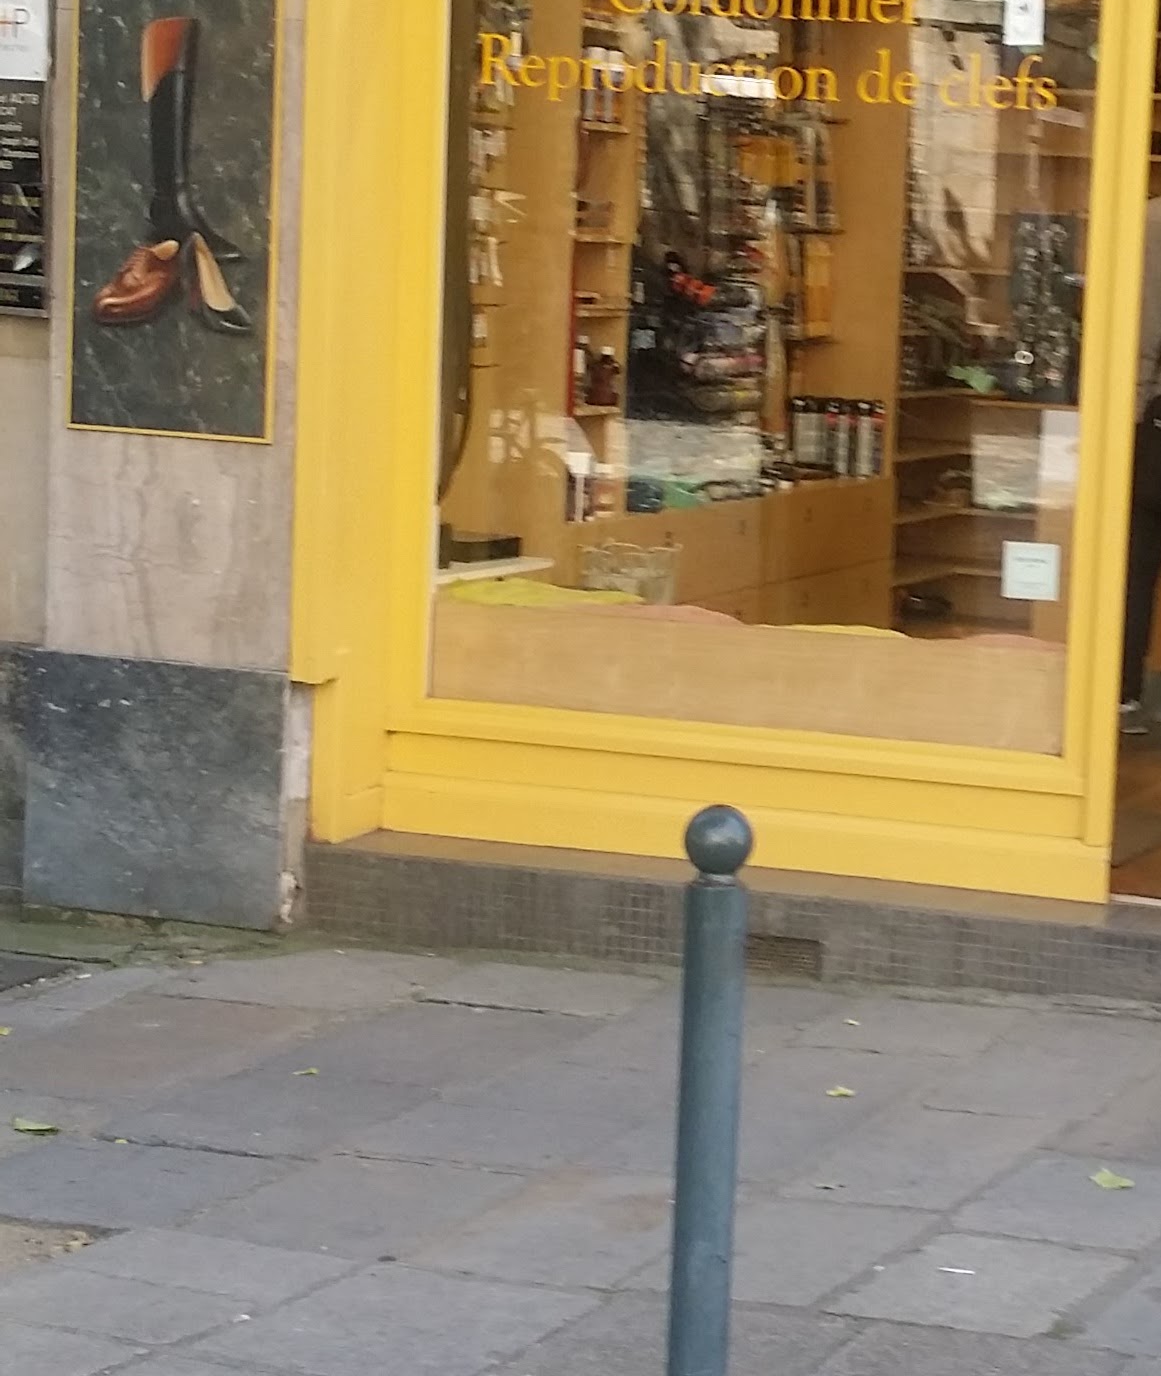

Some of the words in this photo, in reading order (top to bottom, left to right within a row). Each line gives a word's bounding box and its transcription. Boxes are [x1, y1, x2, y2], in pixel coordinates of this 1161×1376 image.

[478, 32, 842, 102] Reproduction
[855, 47, 921, 105] de
[938, 52, 1058, 111] clefs
